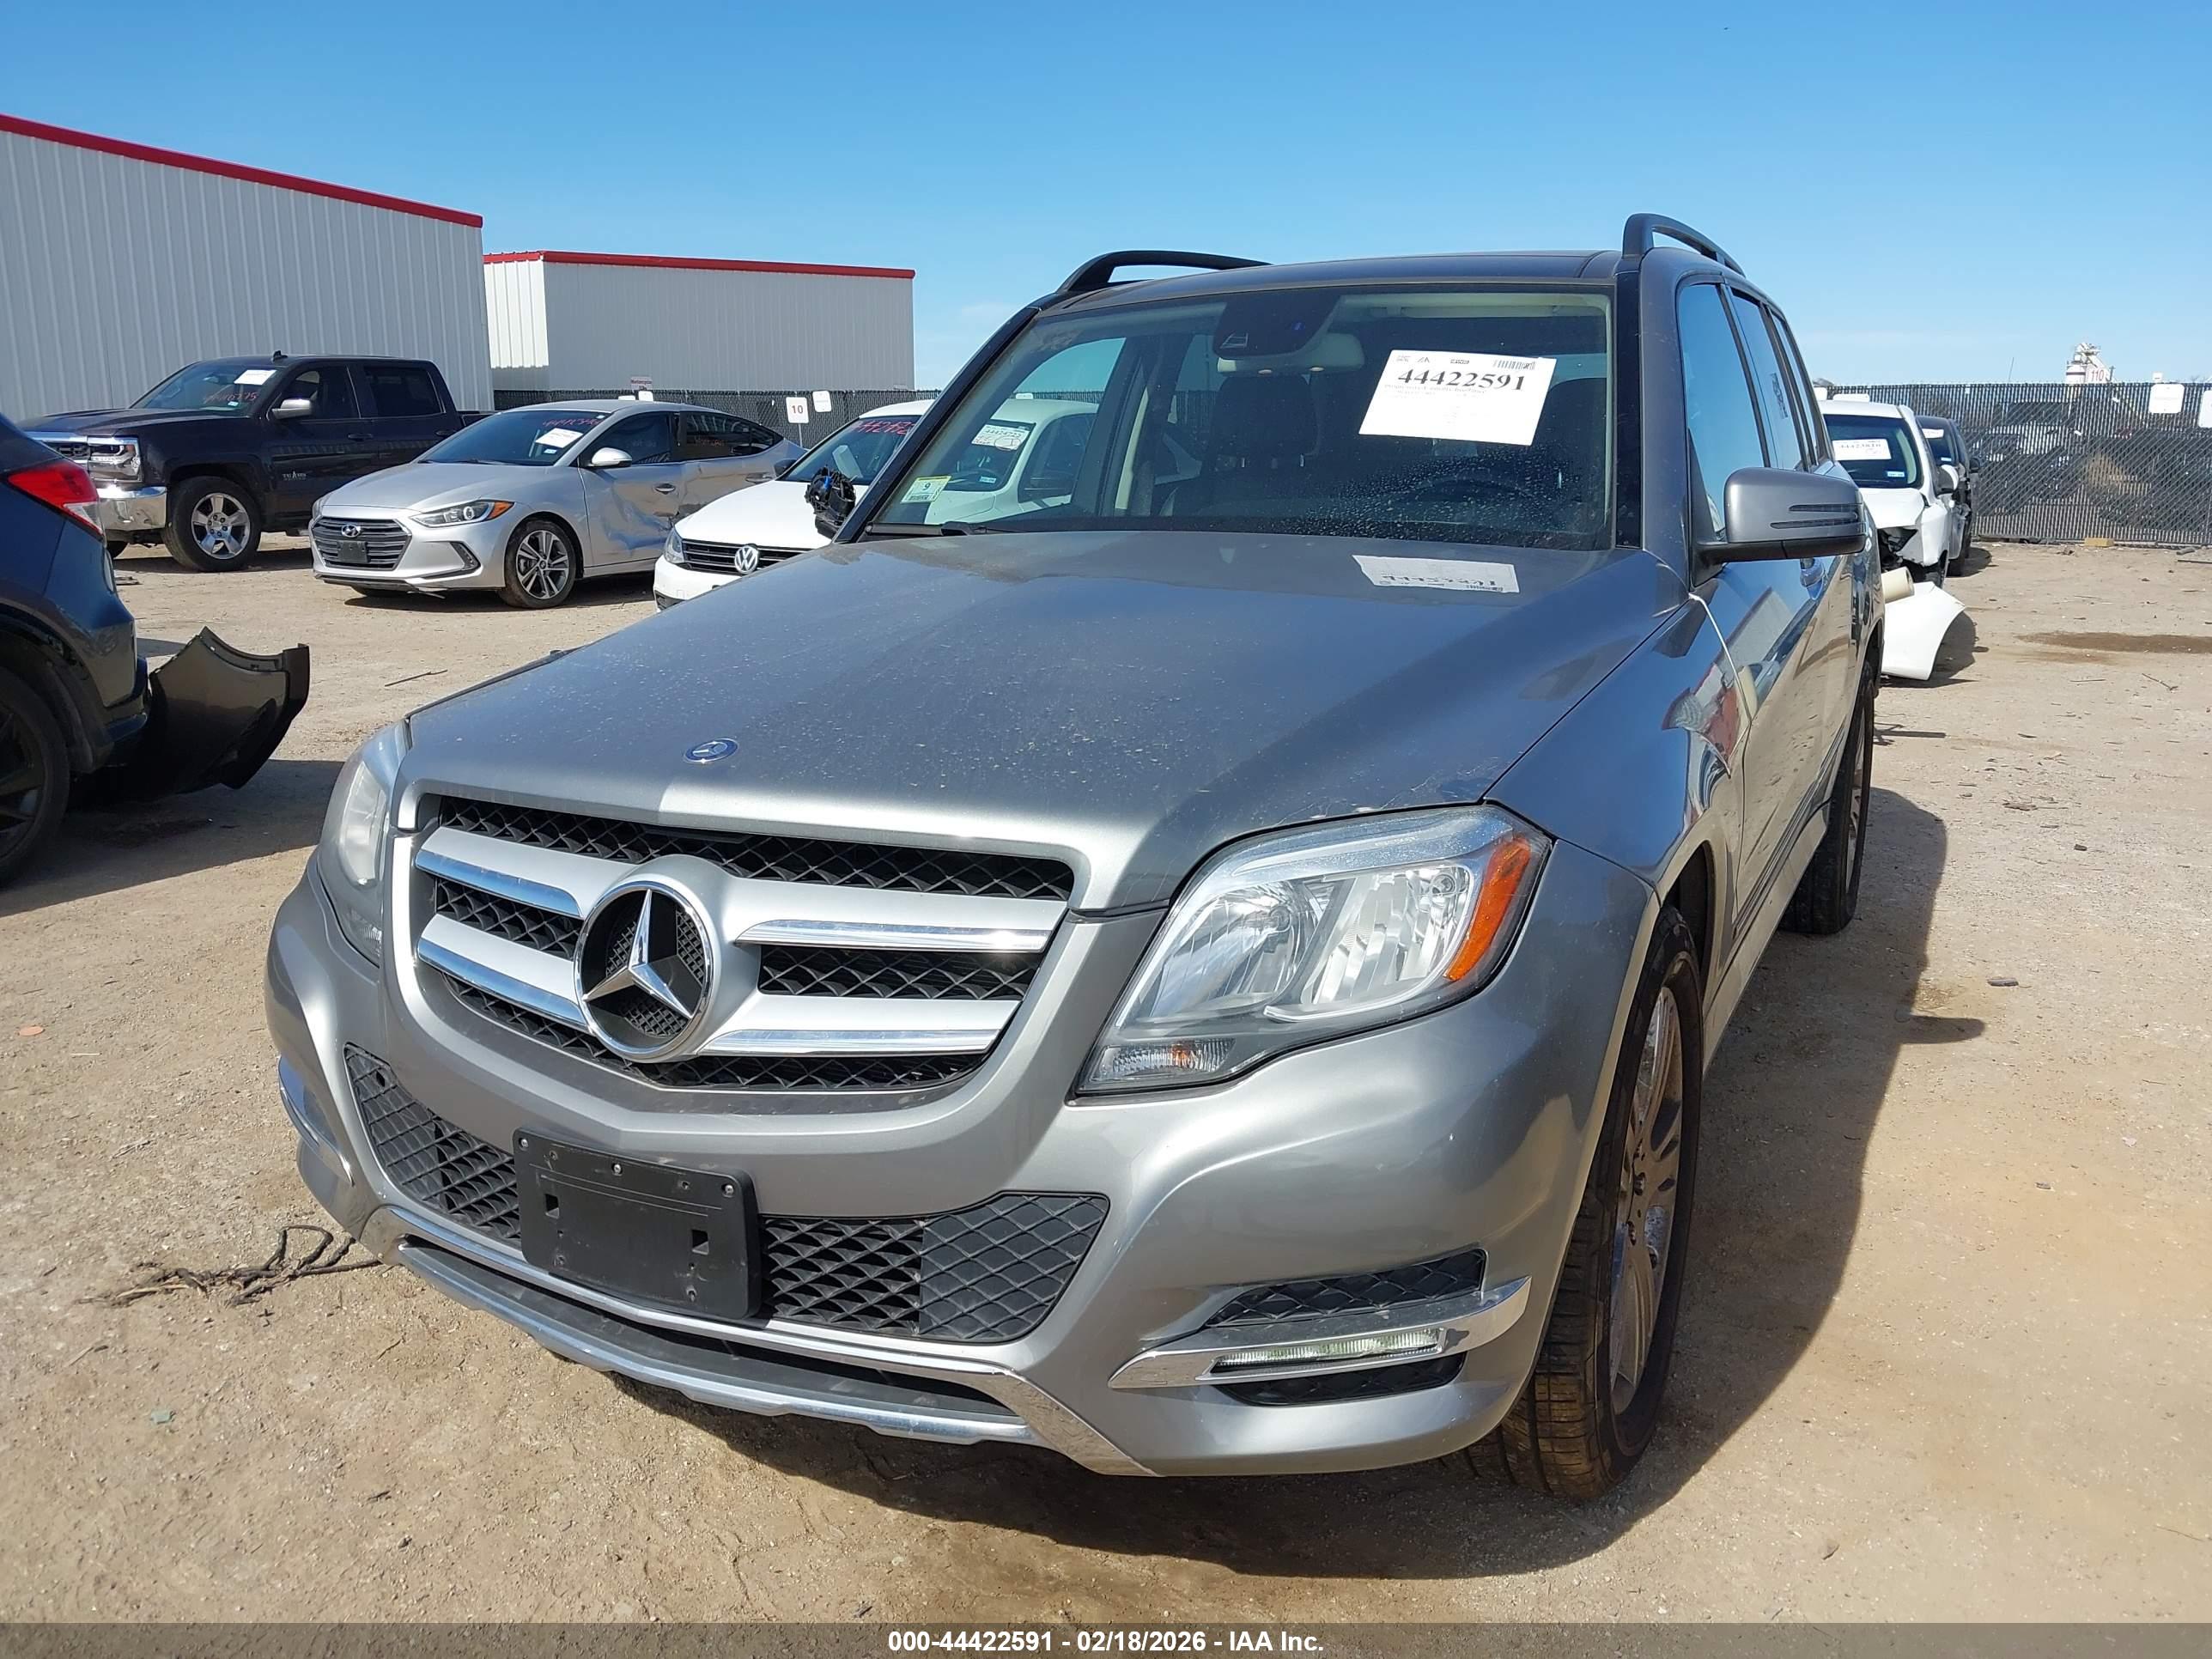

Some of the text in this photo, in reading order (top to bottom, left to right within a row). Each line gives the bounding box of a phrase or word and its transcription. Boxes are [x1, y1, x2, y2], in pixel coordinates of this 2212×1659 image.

[1397, 368, 1525, 391] 44422591
[2091, 369, 2104, 381] 110
[792, 404, 804, 414] 10
[922, 483, 932, 491] 9
